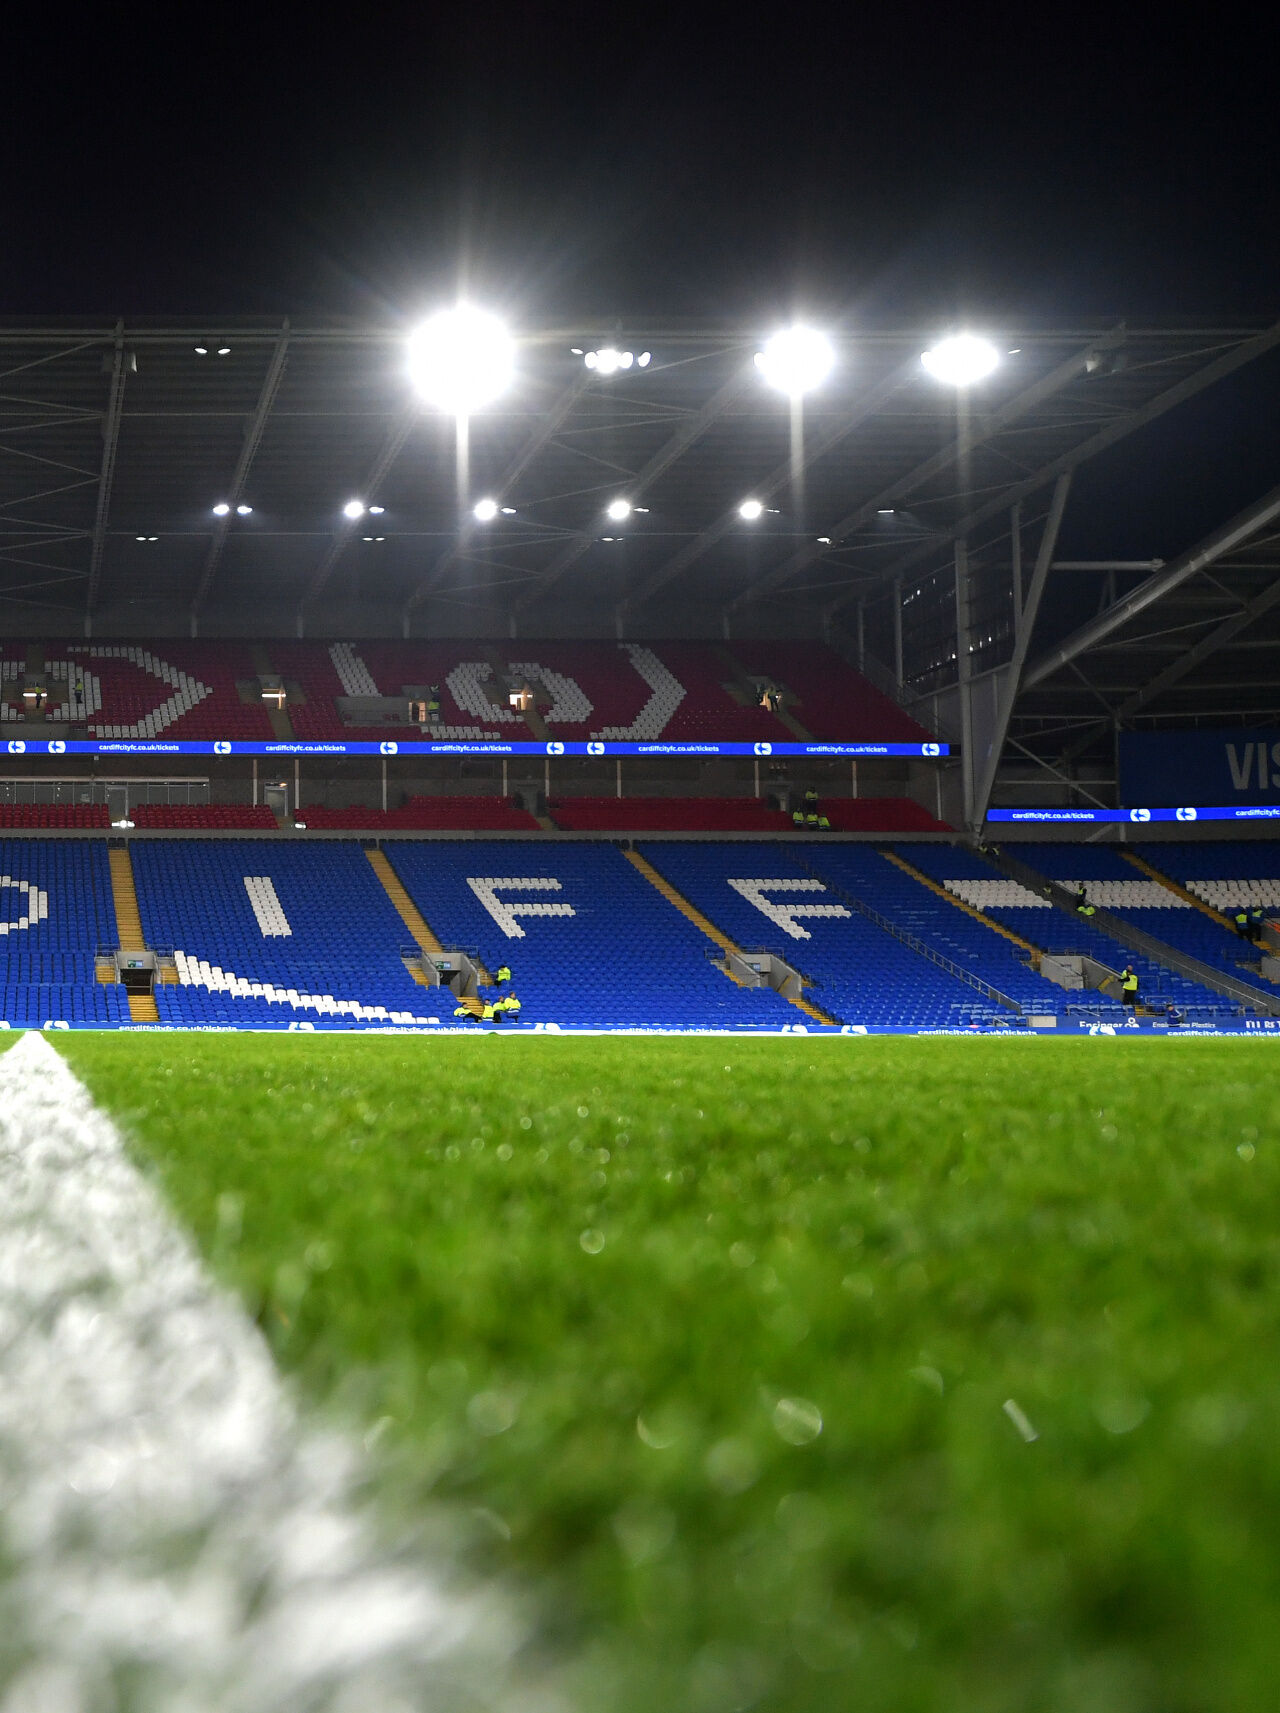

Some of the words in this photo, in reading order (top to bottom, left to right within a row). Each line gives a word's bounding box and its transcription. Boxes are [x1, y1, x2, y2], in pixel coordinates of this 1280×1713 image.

[98, 743, 180, 751] cardiffcityfc.co.uk/tickets
[265, 744, 346, 752] cardiffcityfc.co.uk/tickets
[431, 744, 513, 752] cardiffcityfc.co.uk/tickets
[638, 745, 720, 753] cardiffcityfc.co.uk/tickets
[806, 745, 888, 753] cardiffcityfc.co.uk/tickets
[1012, 812, 1095, 820] cardiffcityfc.co.uk/tickets
